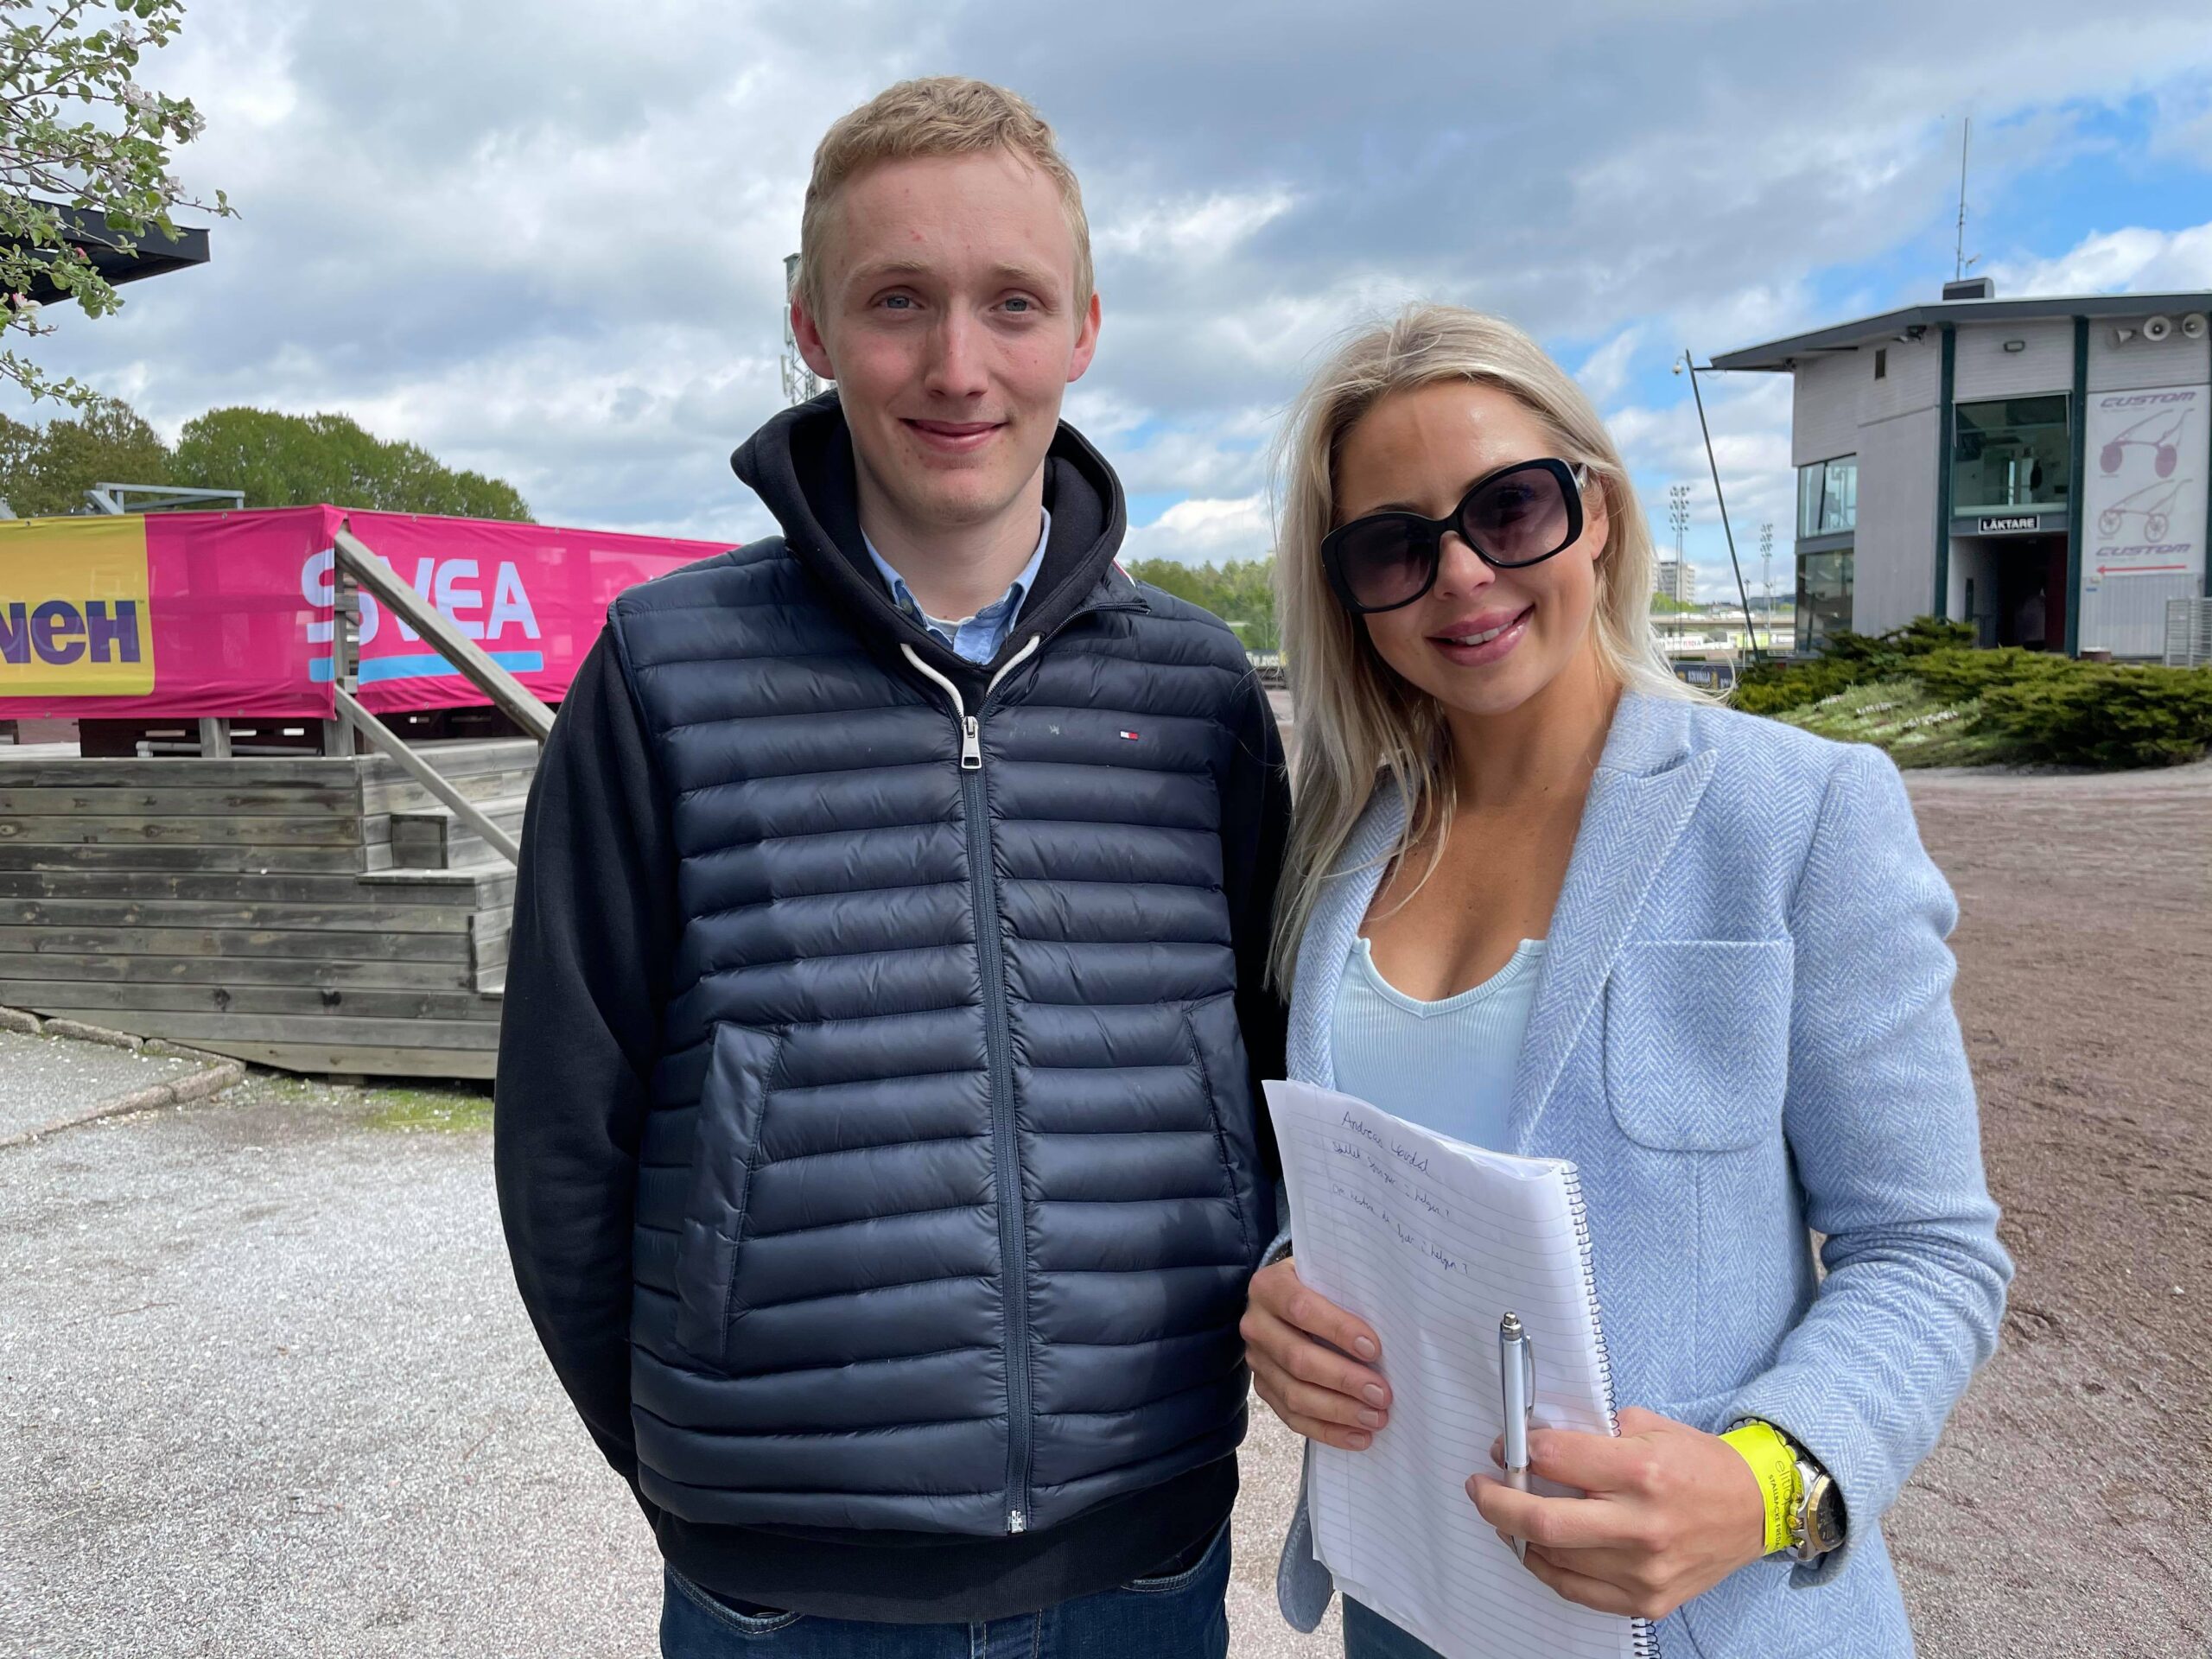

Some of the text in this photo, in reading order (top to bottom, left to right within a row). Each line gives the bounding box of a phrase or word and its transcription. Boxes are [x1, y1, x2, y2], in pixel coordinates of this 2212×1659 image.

[2100, 391, 2196, 408] CUSTOM
[1983, 518, 2035, 531] LÄKTARE
[2095, 543, 2191, 556] CUSTOM
[302, 548, 541, 645] SVEA
[1768, 1474, 1781, 1522] STALLBACKE
